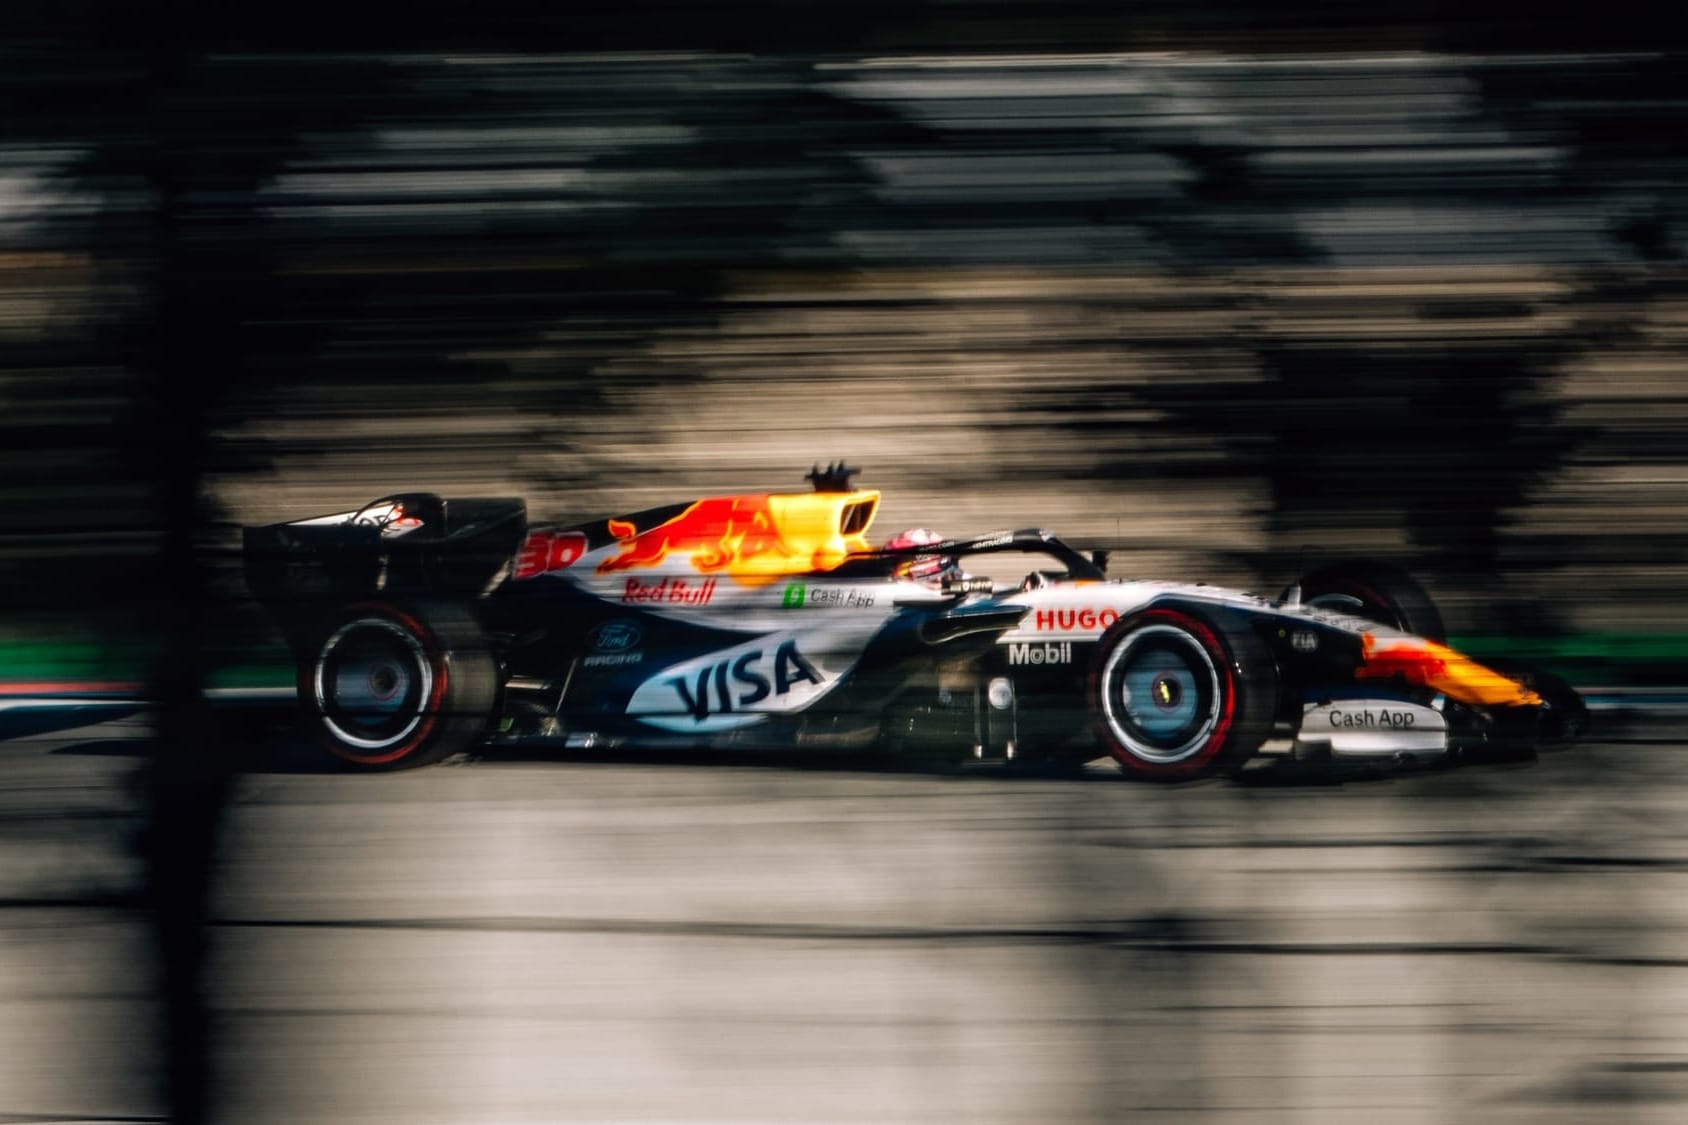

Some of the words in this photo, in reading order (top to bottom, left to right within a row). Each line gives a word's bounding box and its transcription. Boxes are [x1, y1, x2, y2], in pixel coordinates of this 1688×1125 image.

[512, 530, 589, 580] 30
[621, 577, 668, 604] Red
[668, 576, 717, 606] Bull
[810, 588, 845, 605] Cash
[847, 590, 876, 609] App
[1036, 608, 1119, 631] HUGO
[597, 624, 630, 648] Ford
[1292, 632, 1316, 649] FIA
[1009, 641, 1072, 665] Mobil
[662, 639, 826, 723] VISA
[1329, 710, 1375, 727] Cash
[1378, 709, 1415, 729] App
